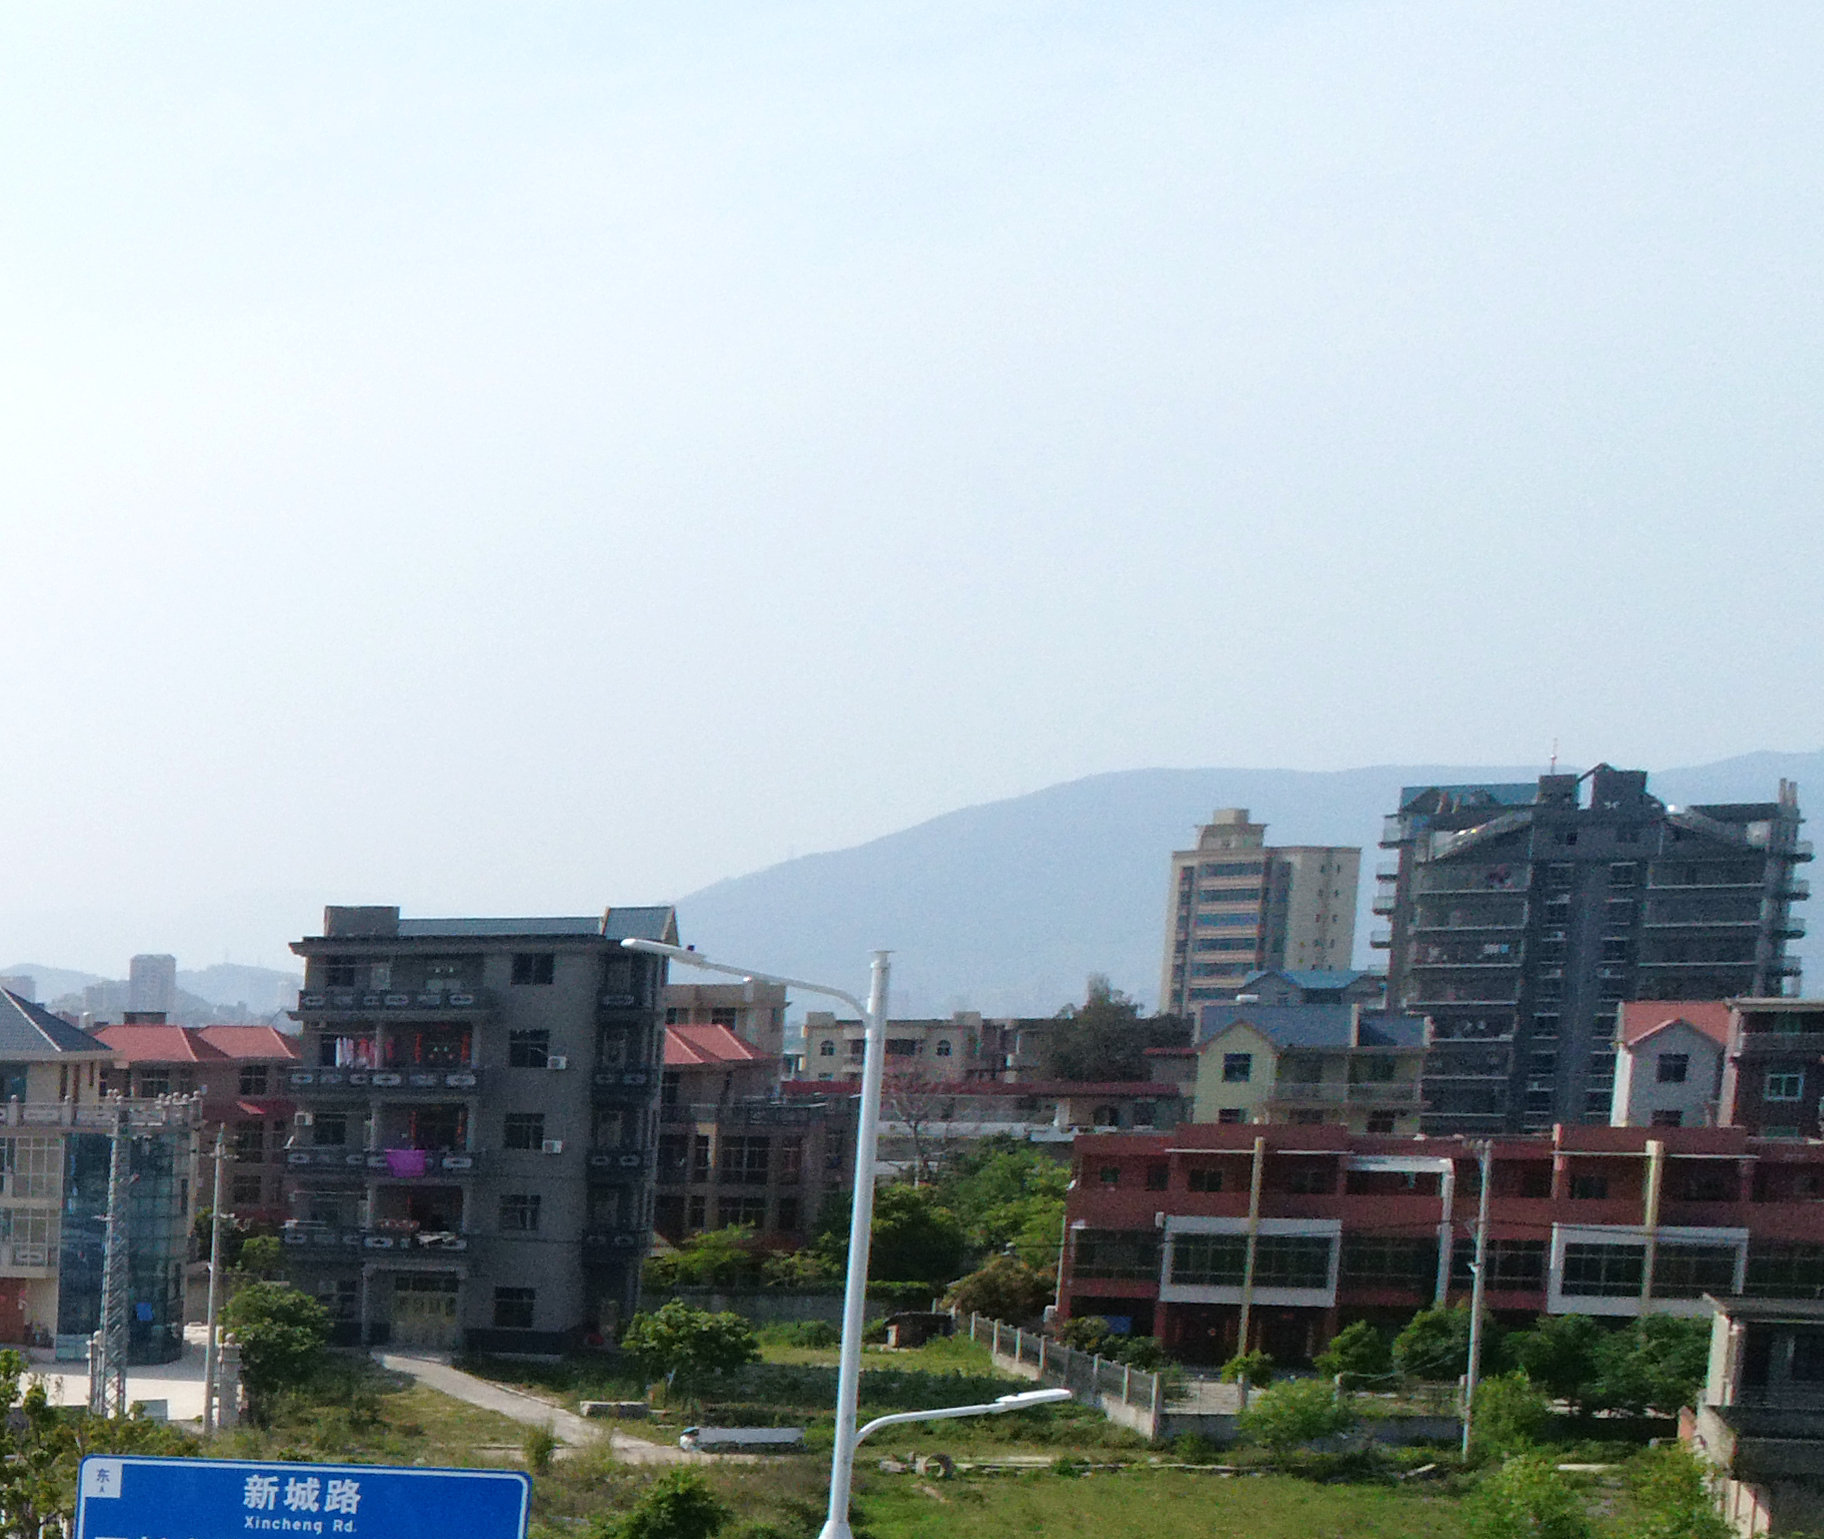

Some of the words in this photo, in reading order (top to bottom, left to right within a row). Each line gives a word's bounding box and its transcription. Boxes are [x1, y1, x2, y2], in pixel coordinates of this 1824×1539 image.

[96, 1468, 110, 1483] 东
[243, 1474, 361, 1514] 新城路
[244, 1516, 323, 1535] Xincheng
[333, 1519, 357, 1533] Rd.
